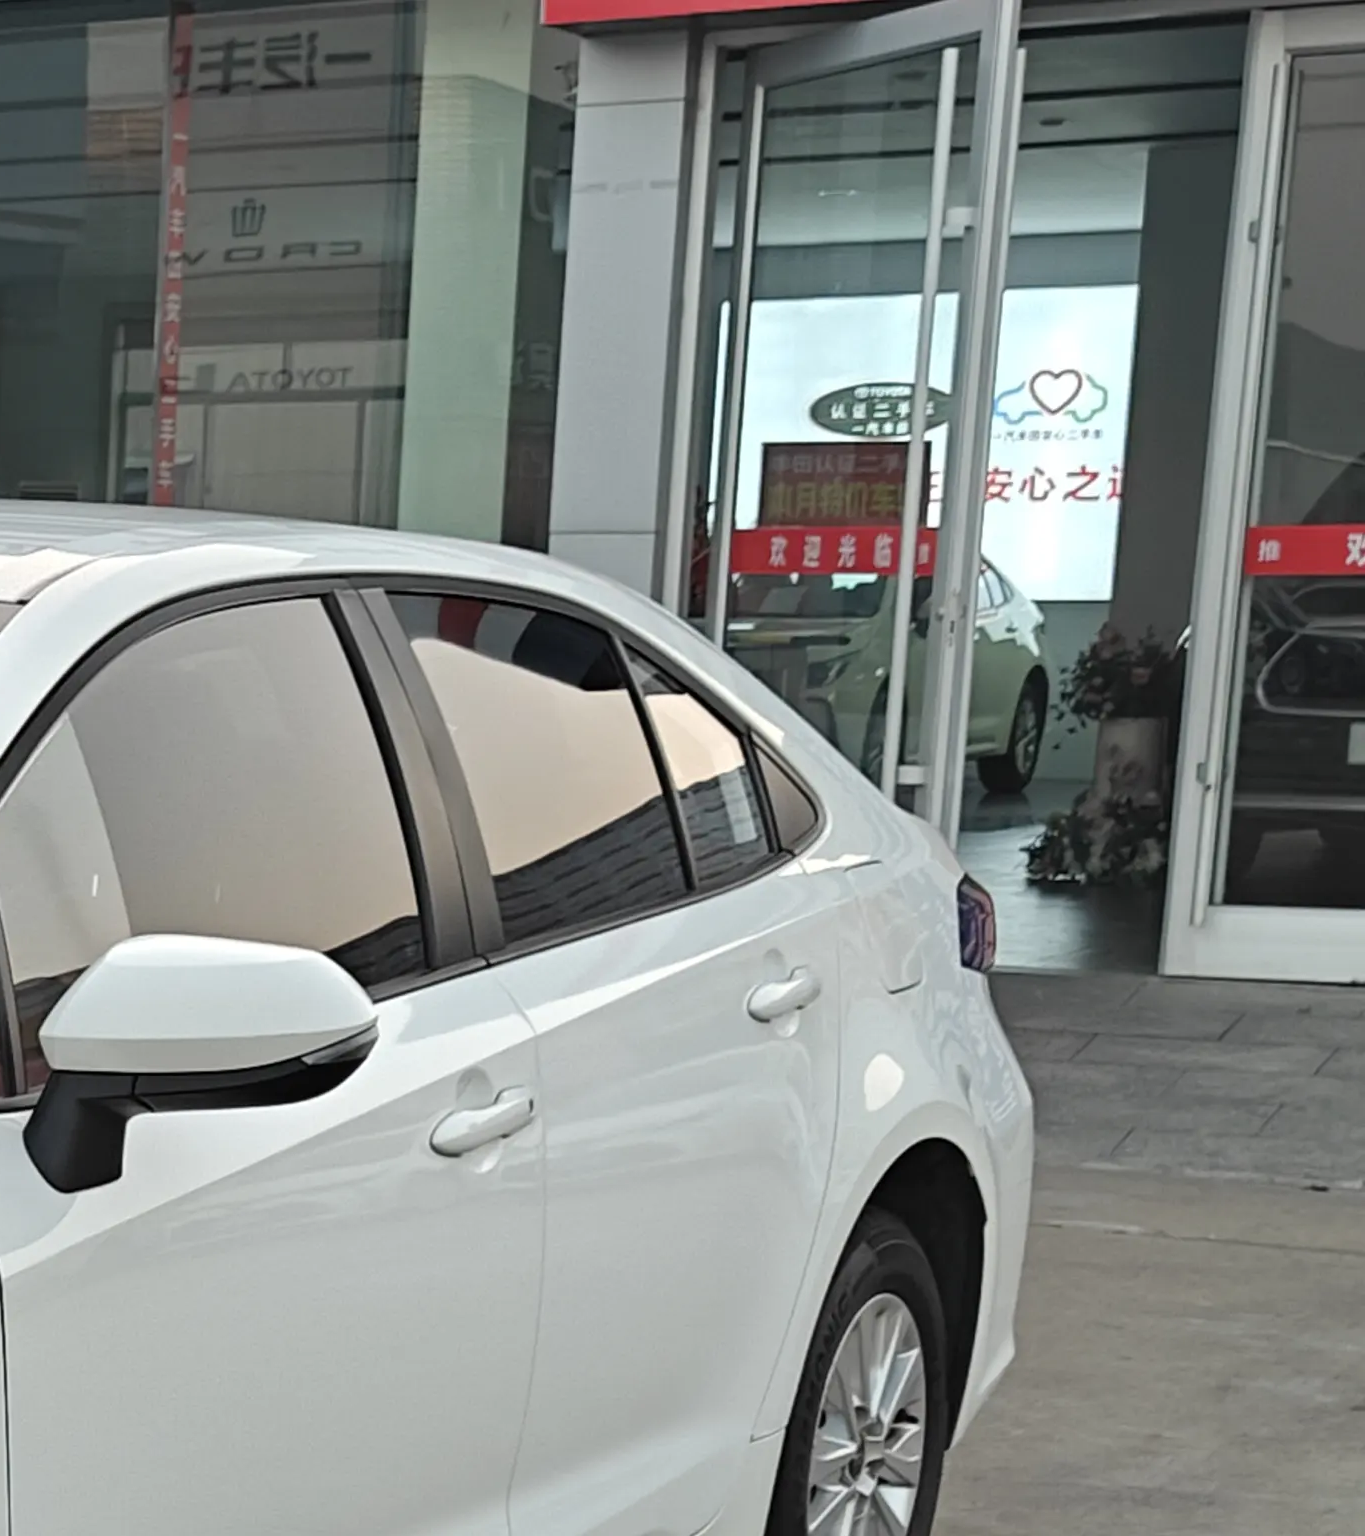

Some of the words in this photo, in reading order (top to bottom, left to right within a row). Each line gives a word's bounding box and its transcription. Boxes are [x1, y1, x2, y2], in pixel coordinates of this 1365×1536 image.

[772, 455, 901, 475] 丰田认证二手
[770, 480, 904, 519] 本月特价车
[769, 533, 893, 568] 欢迎光临
